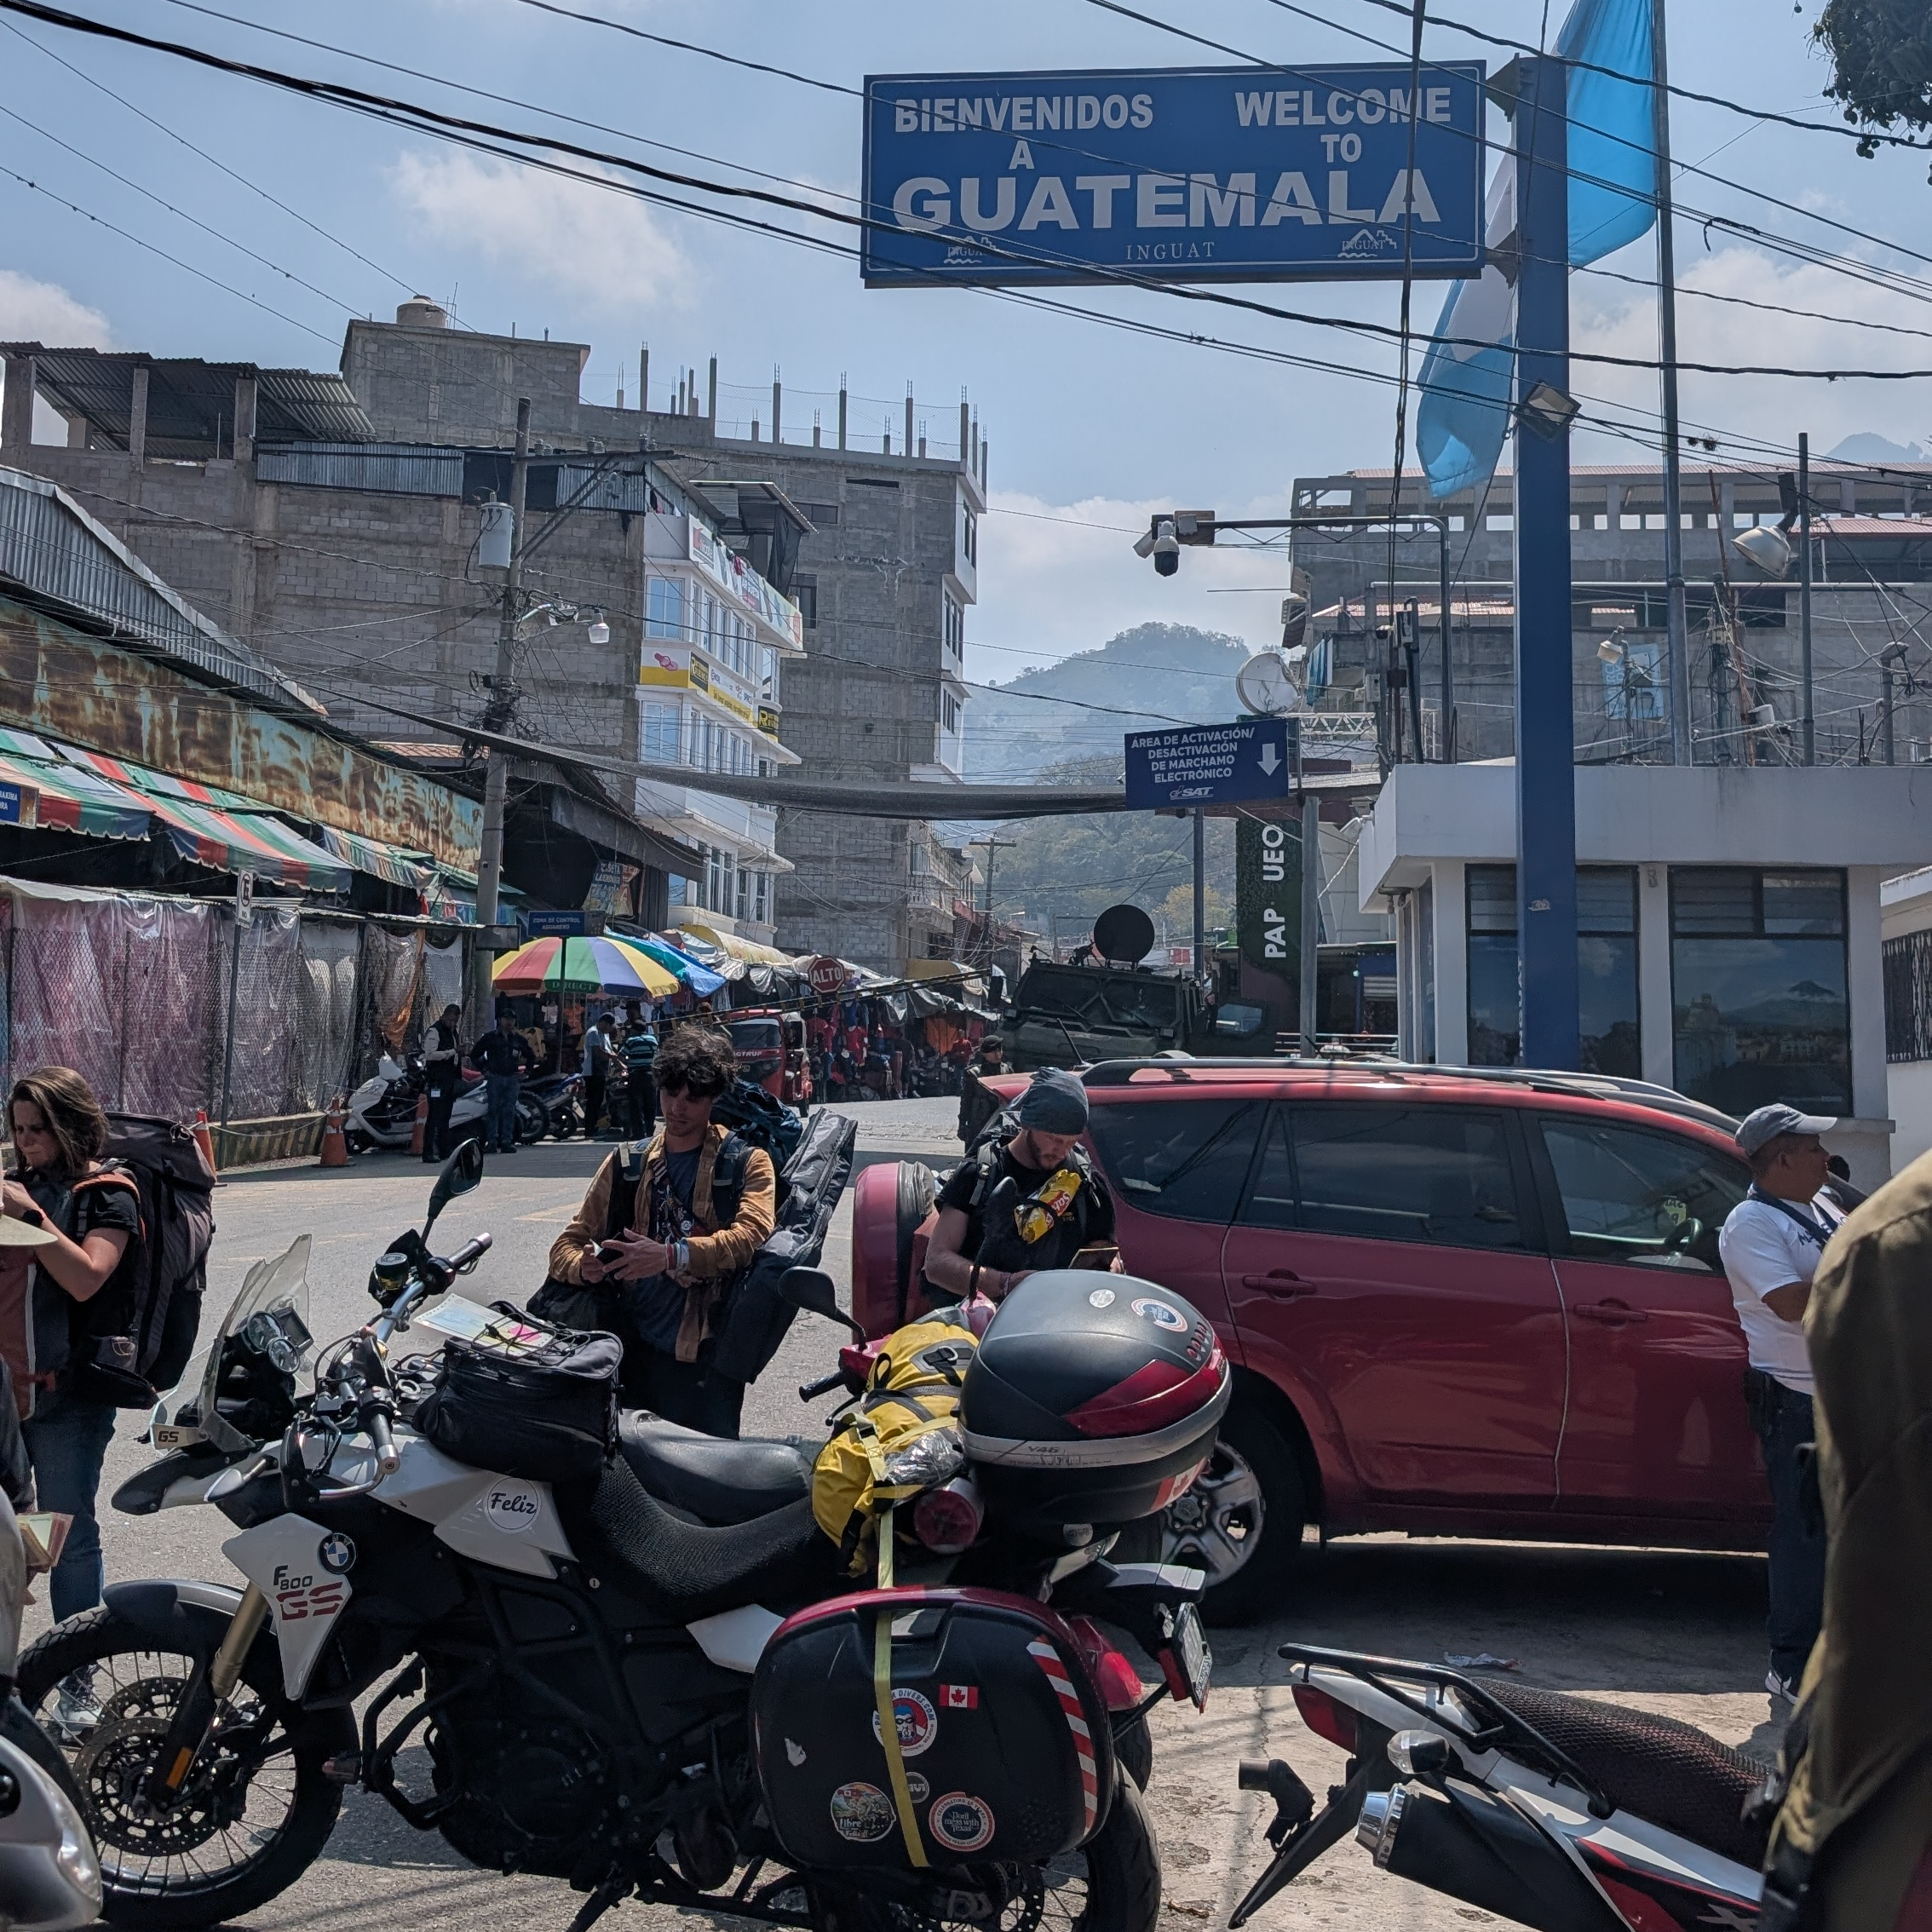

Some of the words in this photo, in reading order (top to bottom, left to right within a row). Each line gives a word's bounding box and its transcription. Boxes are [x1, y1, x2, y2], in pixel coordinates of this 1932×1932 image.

[894, 93, 1153, 133] BIENVENIDOS
[1235, 86, 1452, 127] WELCOME
[1009, 141, 1035, 170] A
[1320, 133, 1363, 163] TO
[892, 169, 1441, 232] GUATEMALA
[1126, 241, 1216, 261] INGUAT
[1130, 736, 1161, 749] ÁREA
[1164, 735, 1179, 745] DE
[1181, 727, 1256, 745] ACTIVACIÓN/
[1147, 740, 1238, 760] DESACTIVACIÓN
[1151, 761, 1166, 771] DE
[1169, 755, 1235, 770] MARCHAMO
[1154, 767, 1233, 784] ELECTRÓNICO
[813, 966, 842, 984] ALTO
[552, 981, 595, 991] DRECT
[158, 1430, 180, 1442] GS
[491, 1492, 538, 1514] Feliz
[279, 1575, 313, 1590] 800
[275, 1581, 344, 1621] GS
